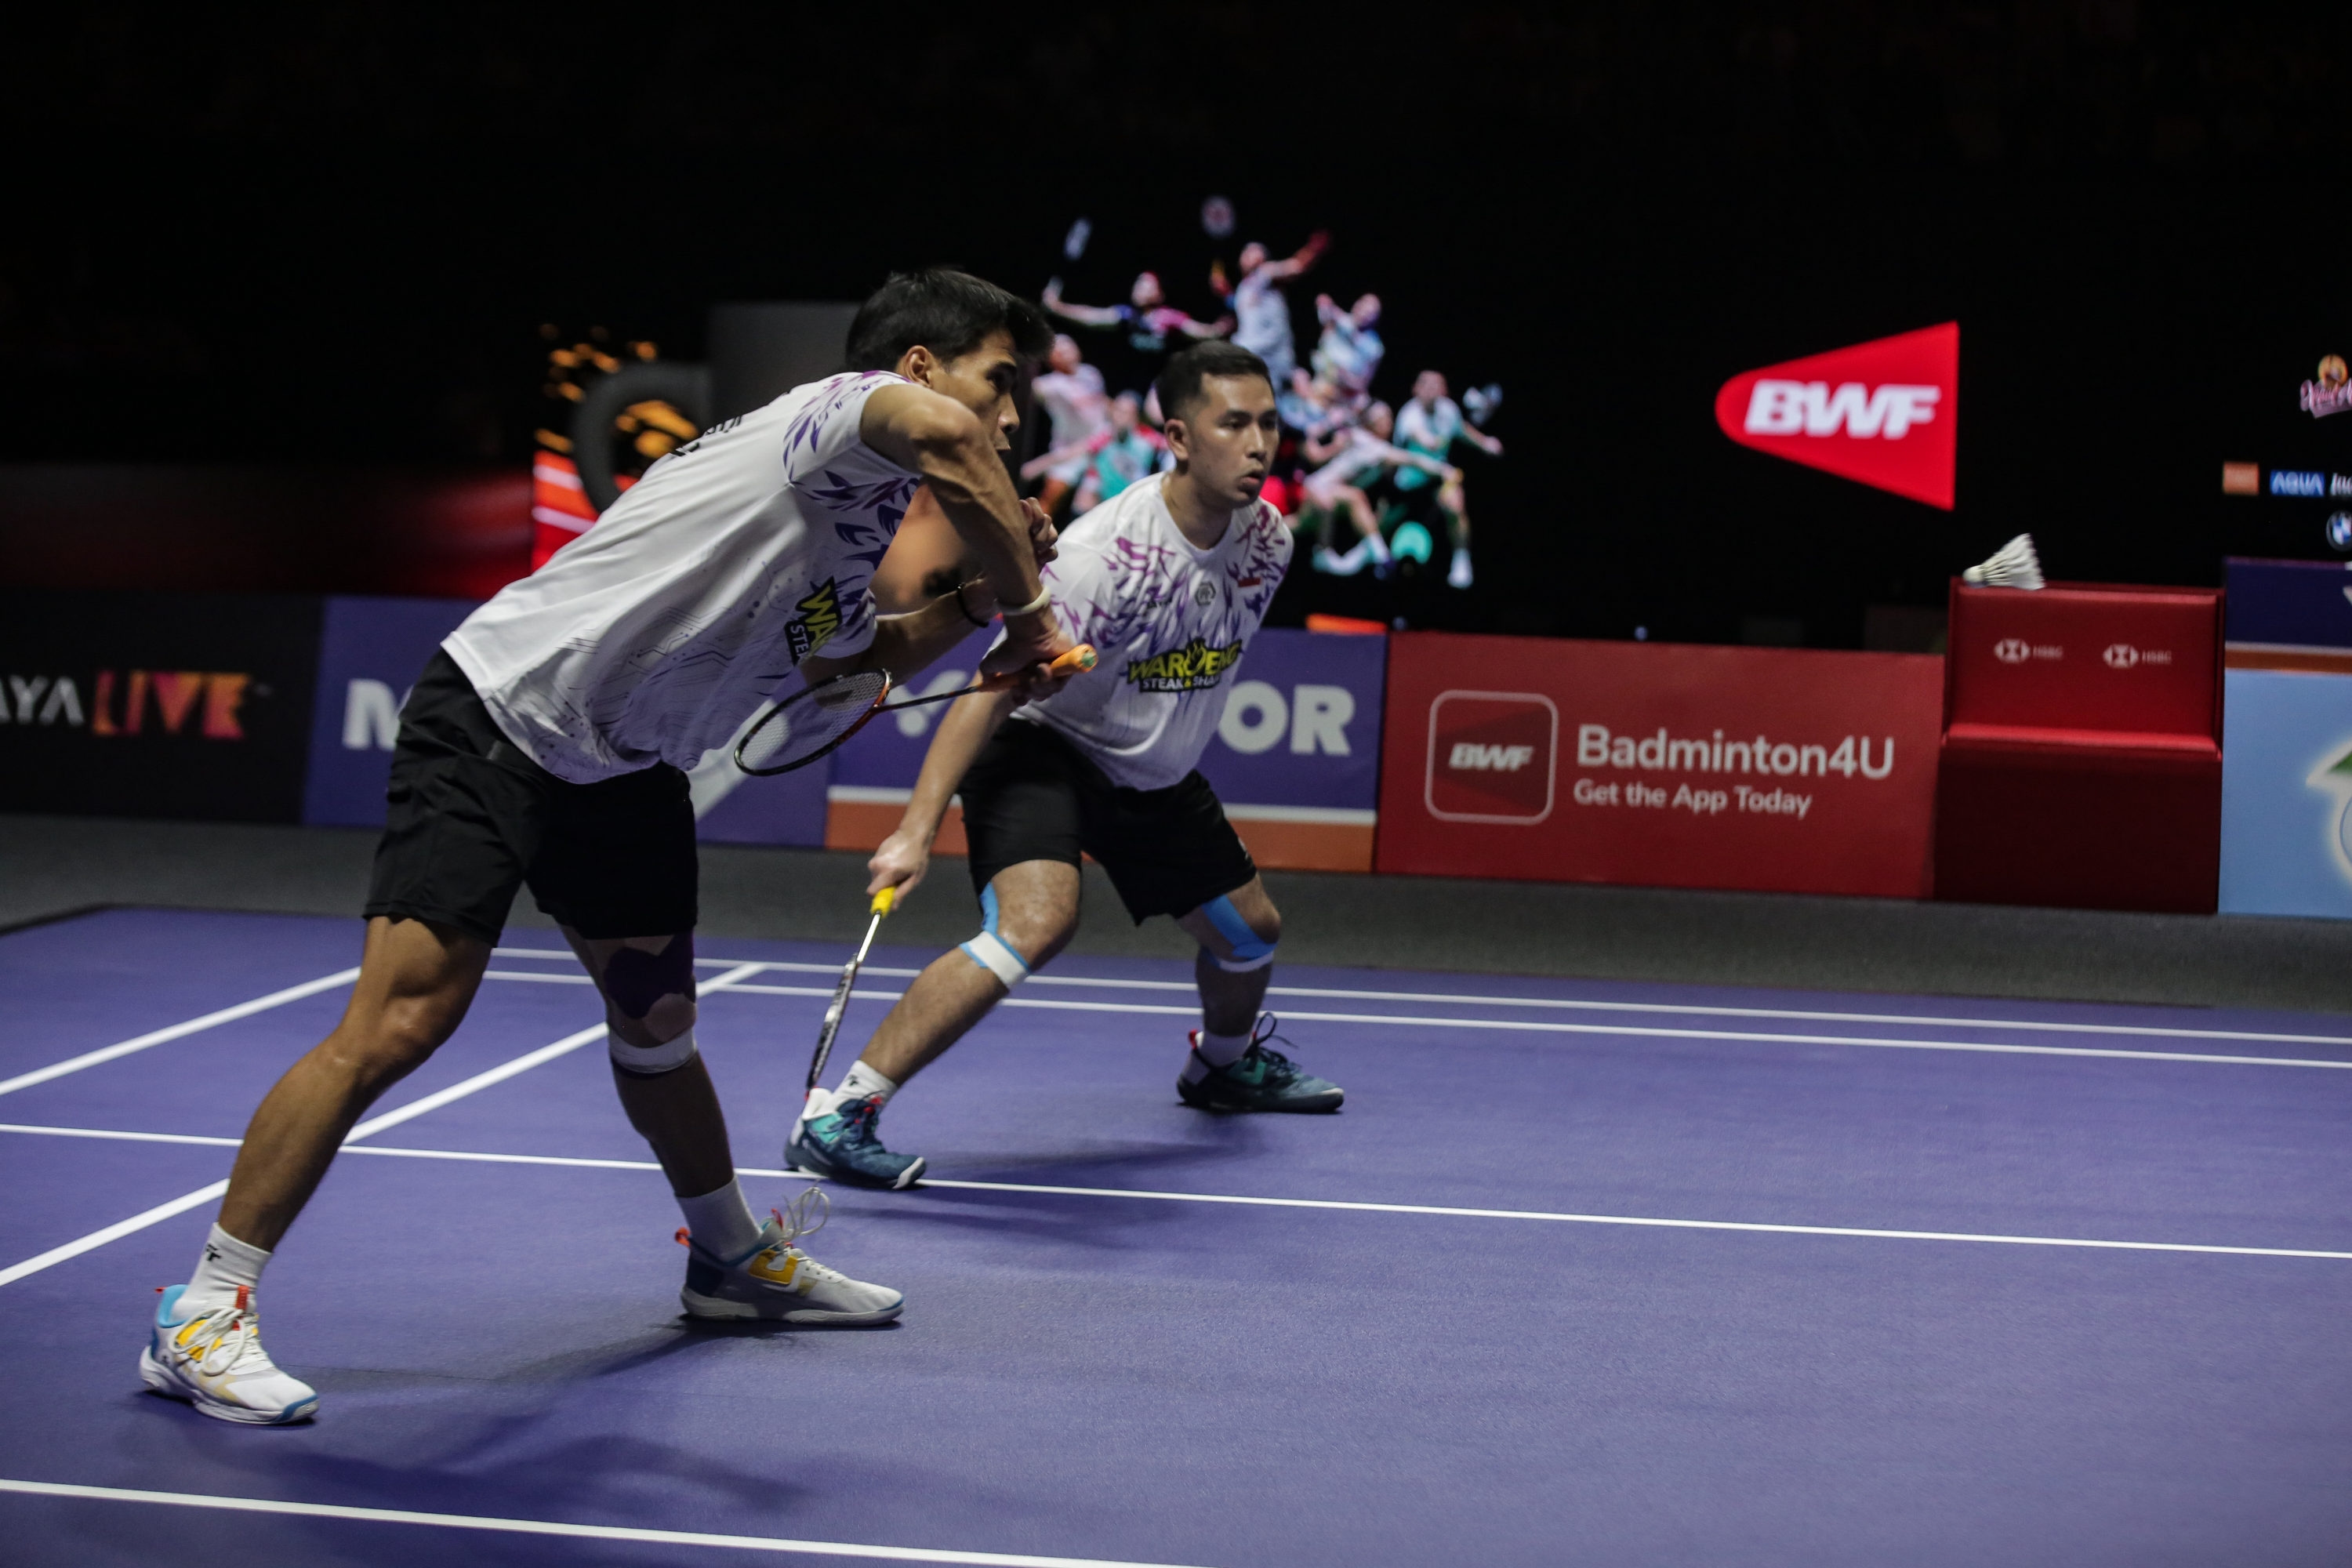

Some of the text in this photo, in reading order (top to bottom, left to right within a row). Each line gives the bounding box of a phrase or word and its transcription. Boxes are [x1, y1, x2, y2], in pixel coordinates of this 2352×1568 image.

[1744, 379, 1941, 440] BWF
[2271, 471, 2323, 495] AQUA
[1142, 676, 1184, 691] STEAK
[93, 671, 249, 739] LIVE
[1449, 742, 1534, 771] BWF
[1577, 723, 1895, 779] Badminton4U
[1573, 778, 1812, 820] Get the App Today
